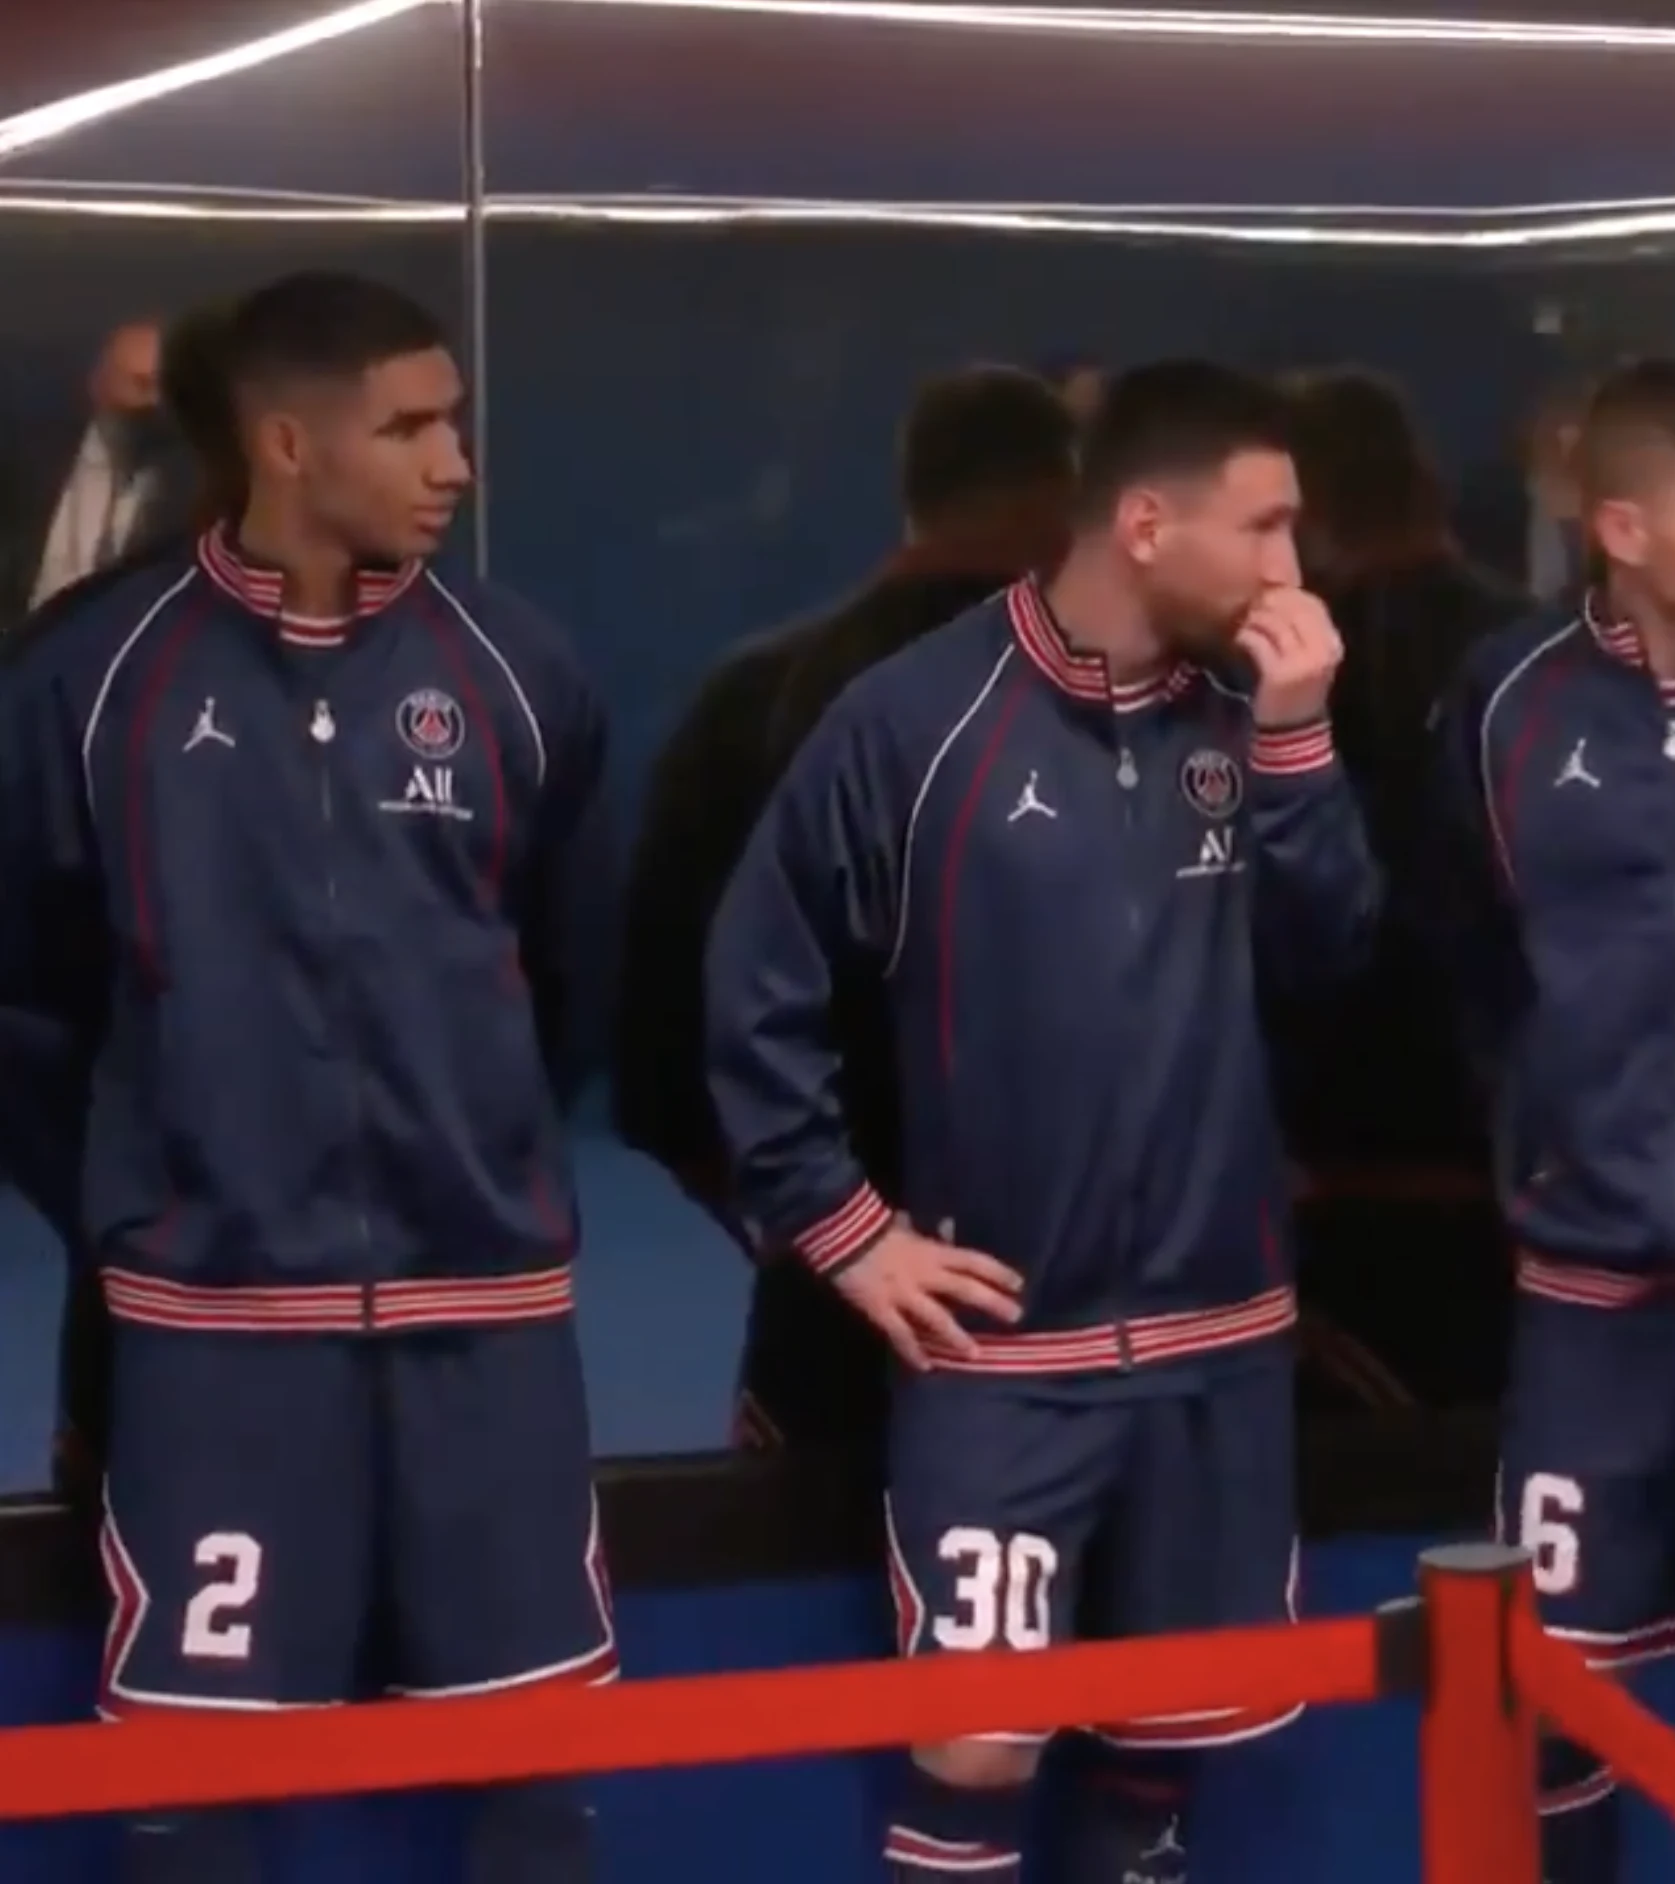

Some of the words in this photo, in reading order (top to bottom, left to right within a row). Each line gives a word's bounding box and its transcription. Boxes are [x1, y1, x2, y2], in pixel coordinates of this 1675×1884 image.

[404, 764, 453, 803] All
[181, 1530, 262, 1657] 2
[932, 1525, 1058, 1652] 30
[1520, 1471, 1584, 1596] 6
